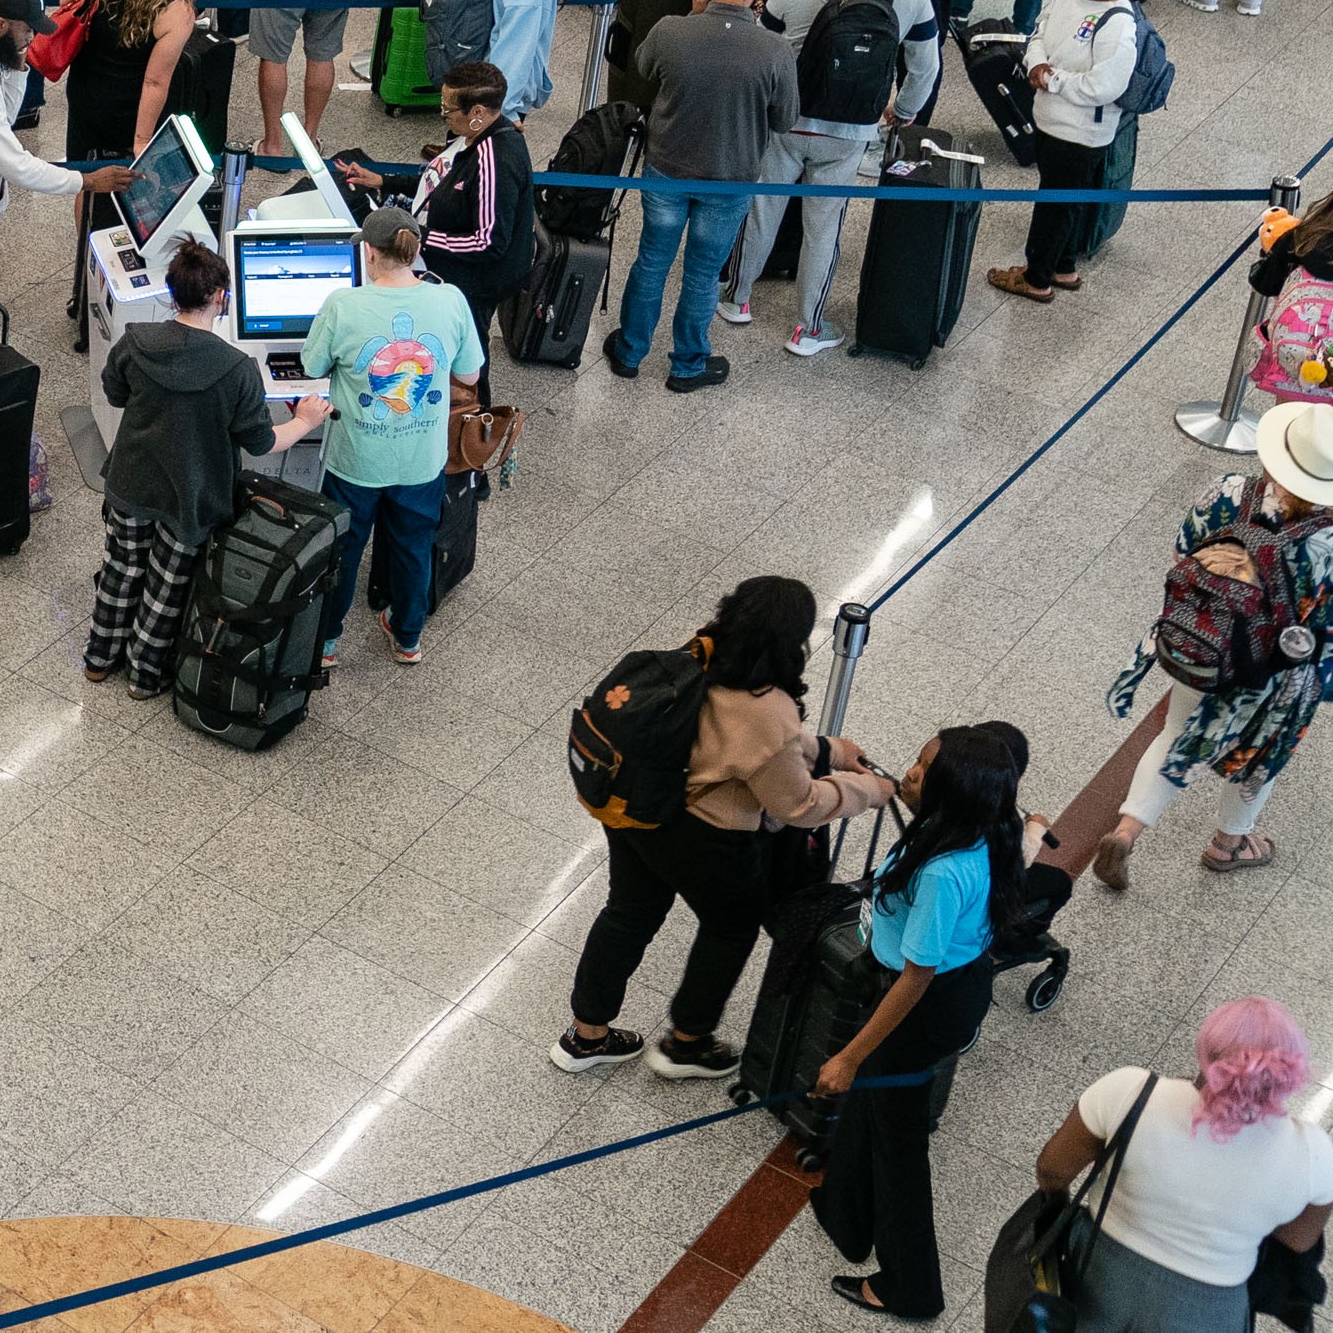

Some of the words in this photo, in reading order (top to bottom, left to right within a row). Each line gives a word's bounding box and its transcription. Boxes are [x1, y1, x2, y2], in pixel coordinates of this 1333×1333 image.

[355, 418, 390, 434] simply
[393, 417, 439, 433] southern
[264, 467, 311, 475] DELTA
